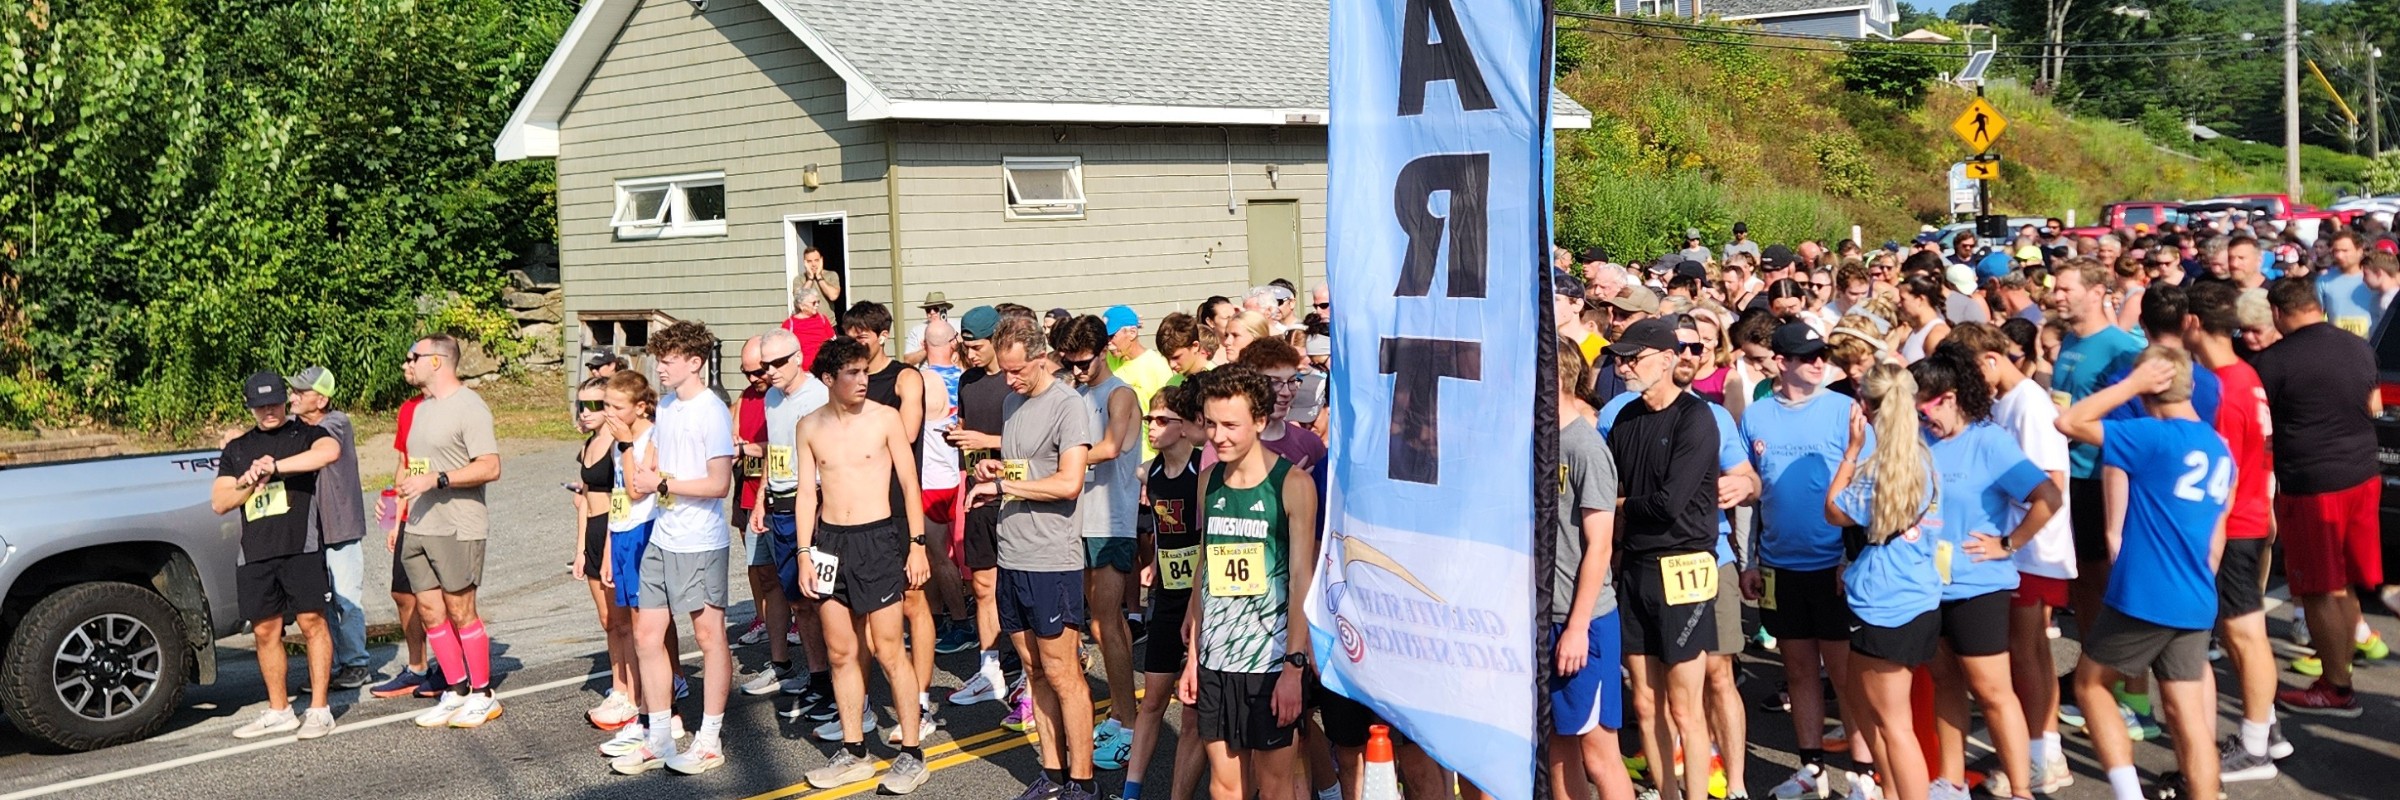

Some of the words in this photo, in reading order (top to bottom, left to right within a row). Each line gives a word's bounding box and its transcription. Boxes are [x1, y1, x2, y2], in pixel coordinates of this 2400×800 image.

[2173, 450, 2231, 505] 24
[254, 493, 271, 509] 81
[1207, 516, 1269, 539] KINGSWOOD
[1169, 559, 1193, 580] 84
[1225, 558, 1250, 582] 46
[1675, 566, 1710, 591] 117
